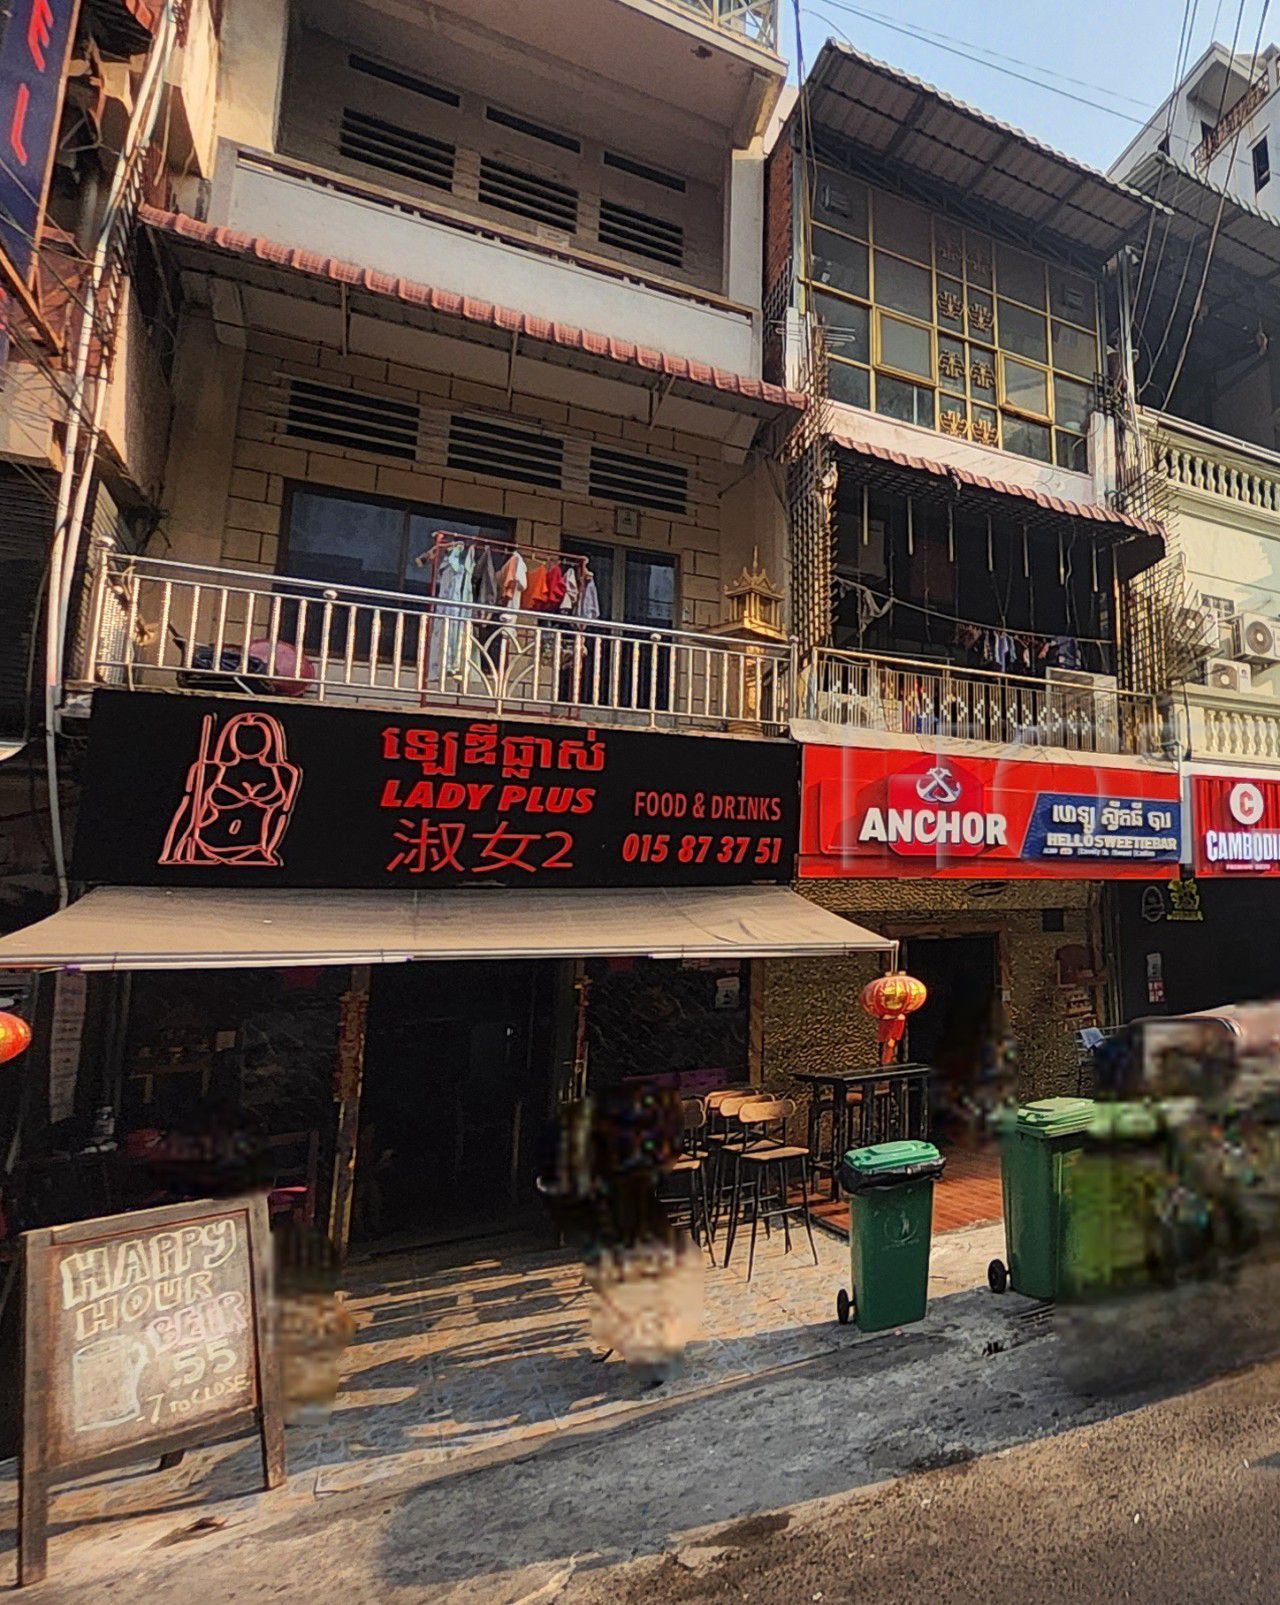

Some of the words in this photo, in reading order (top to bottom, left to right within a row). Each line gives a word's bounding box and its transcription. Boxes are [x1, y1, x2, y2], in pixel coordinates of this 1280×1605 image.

[379, 780, 495, 811] LADY
[498, 785, 597, 814] PLUS
[634, 791, 686, 819] FOOD
[692, 793, 705, 820] &
[710, 793, 782, 822] DRINKS
[386, 817, 575, 874] 淑女2
[858, 806, 1007, 846] ANCHOR
[621, 832, 670, 864] 015
[677, 835, 711, 865] 87
[716, 835, 749, 865] 37
[753, 836, 783, 866] 51
[60, 1219, 237, 1310] HAPPY
[75, 1270, 214, 1342] HOUR
